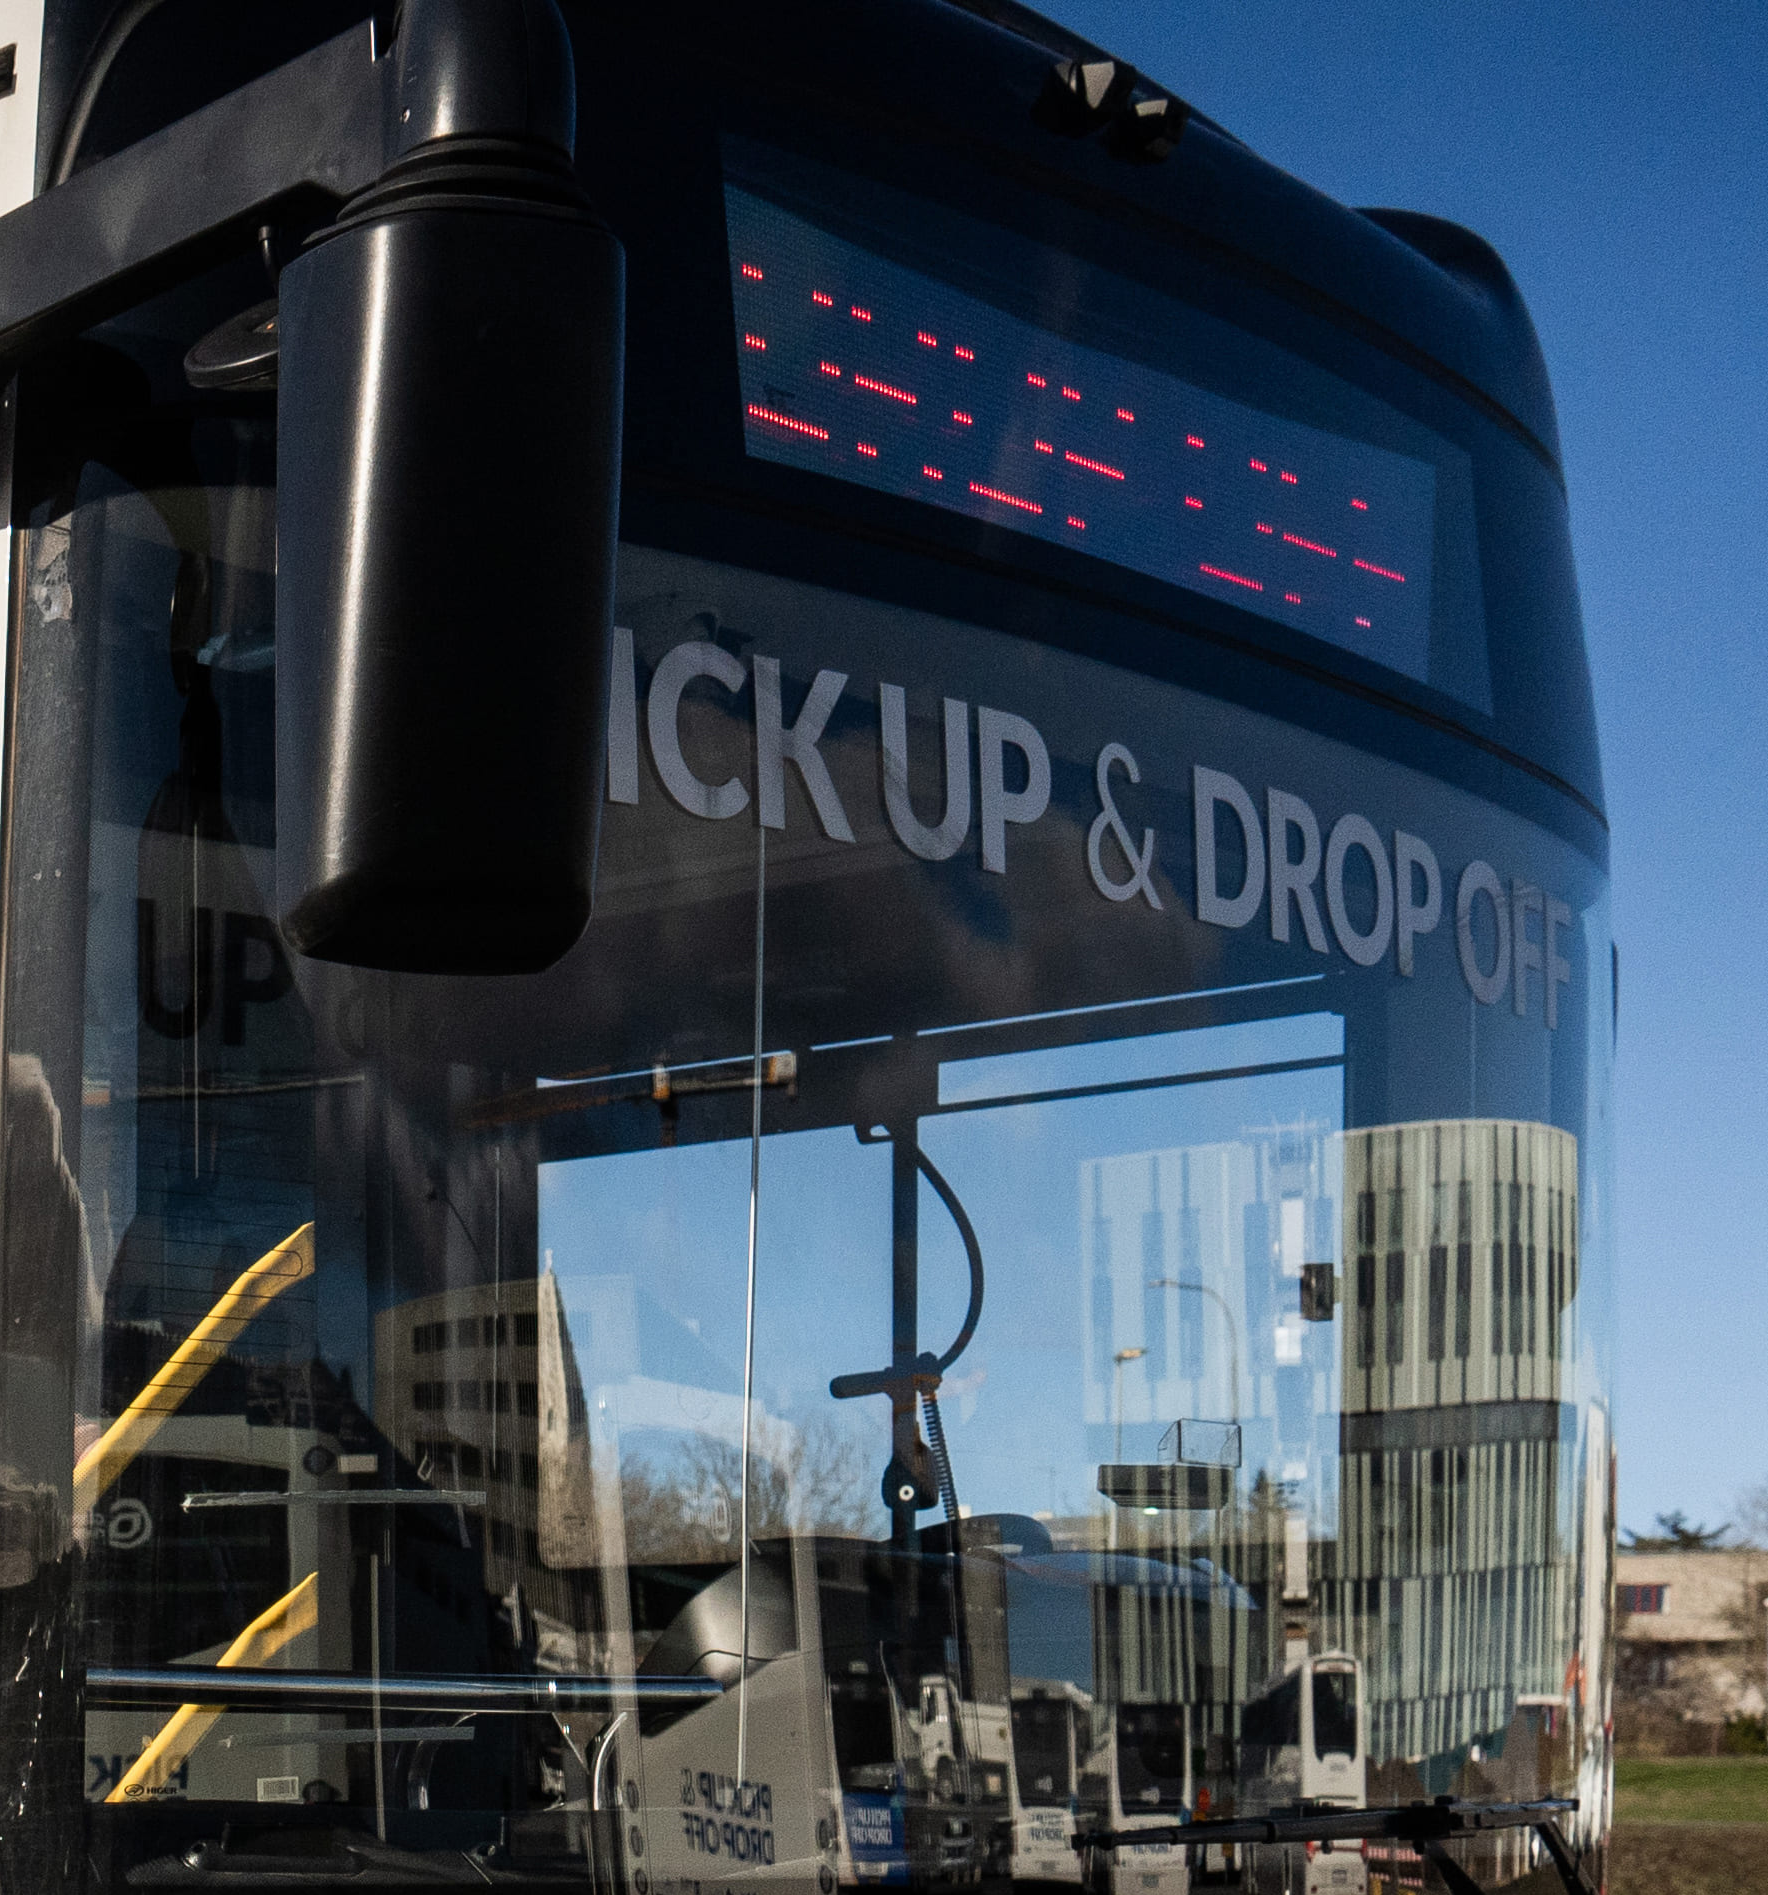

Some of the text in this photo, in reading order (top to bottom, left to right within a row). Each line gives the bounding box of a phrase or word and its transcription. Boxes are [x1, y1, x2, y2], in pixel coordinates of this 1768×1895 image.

[608, 626, 1571, 1030] ICK UP & DROP OFF
